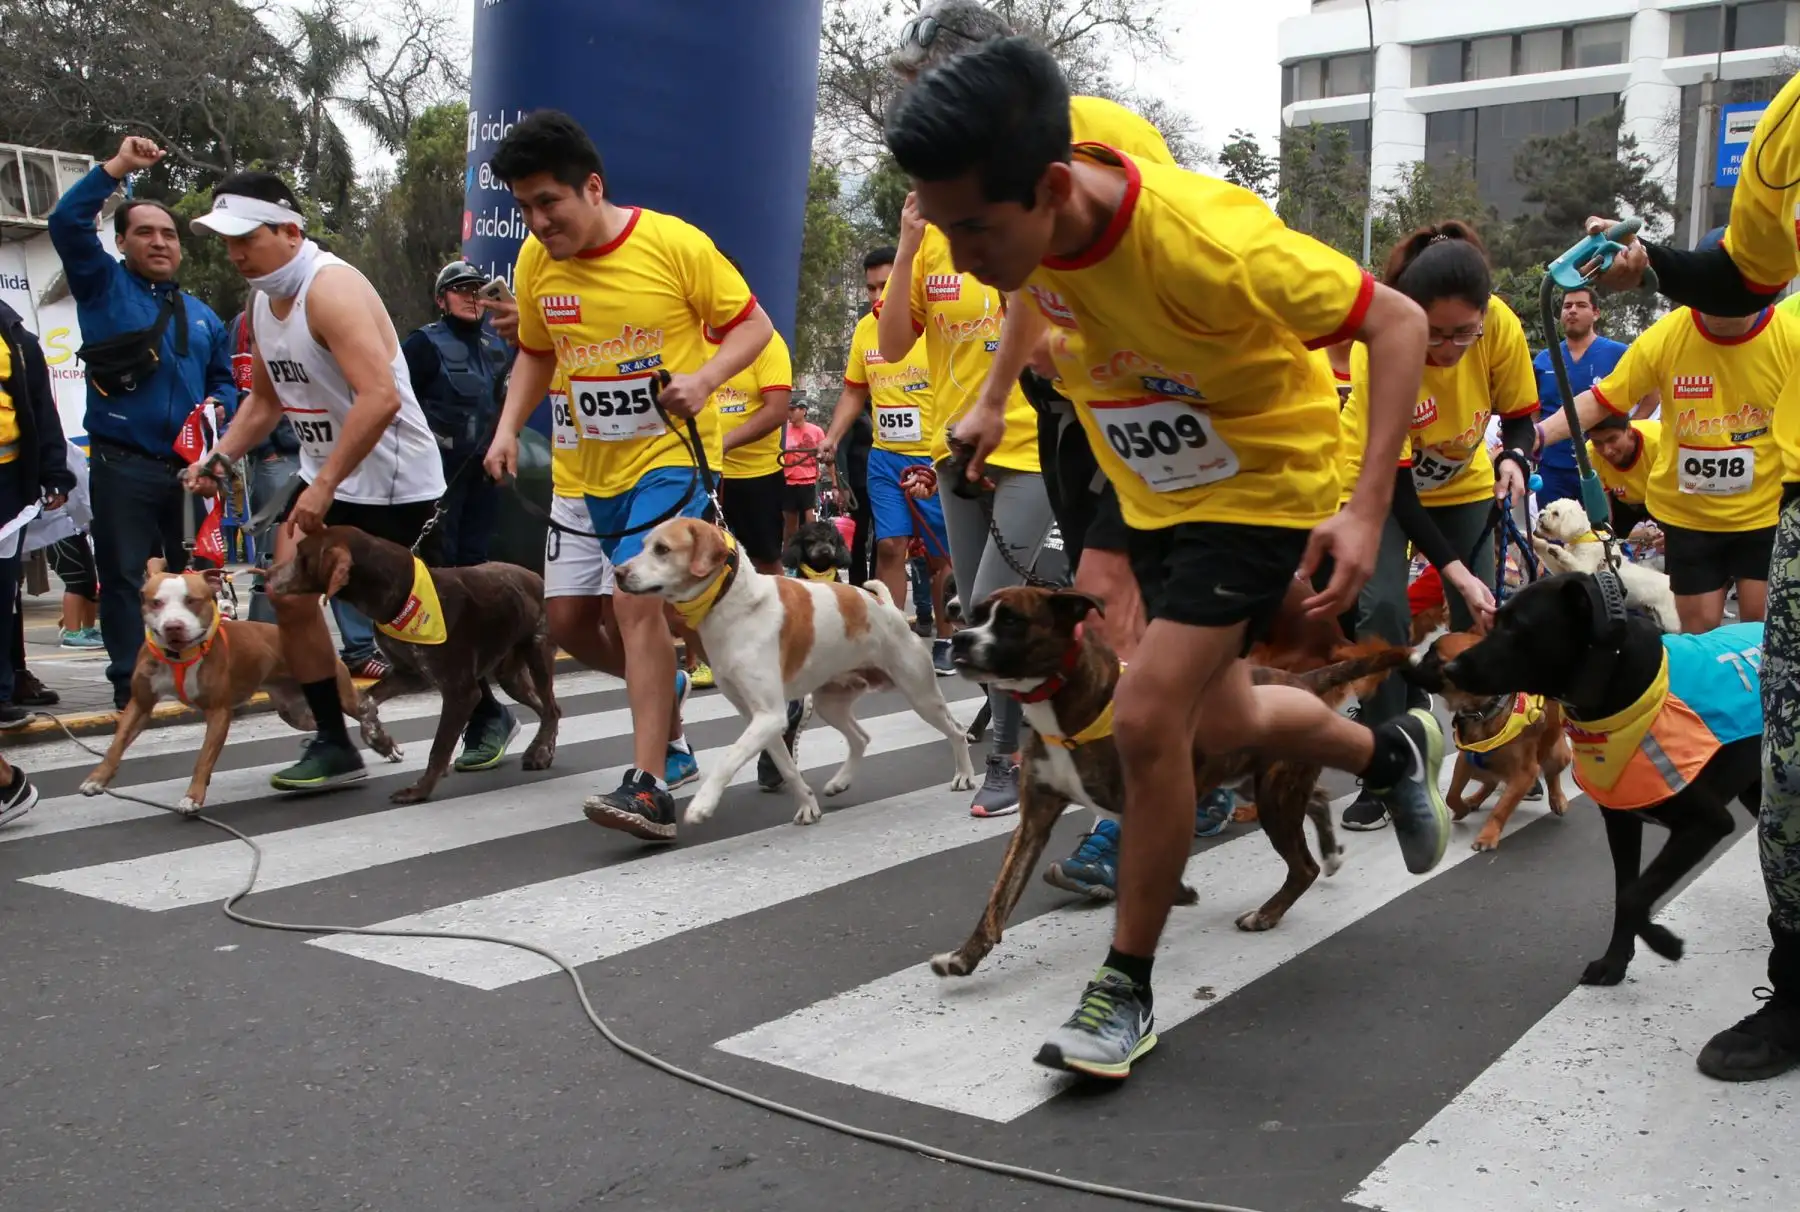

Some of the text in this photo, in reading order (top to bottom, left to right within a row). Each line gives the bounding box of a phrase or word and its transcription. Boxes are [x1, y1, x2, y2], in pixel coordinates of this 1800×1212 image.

[46, 327, 73, 365] S
[620, 355, 661, 373] 2K 4K 6K
[579, 387, 651, 417] 0525
[294, 420, 333, 442] 0517
[879, 413, 913, 428] 0515
[1106, 413, 1207, 459] 0509
[1684, 457, 1745, 478] 0518
